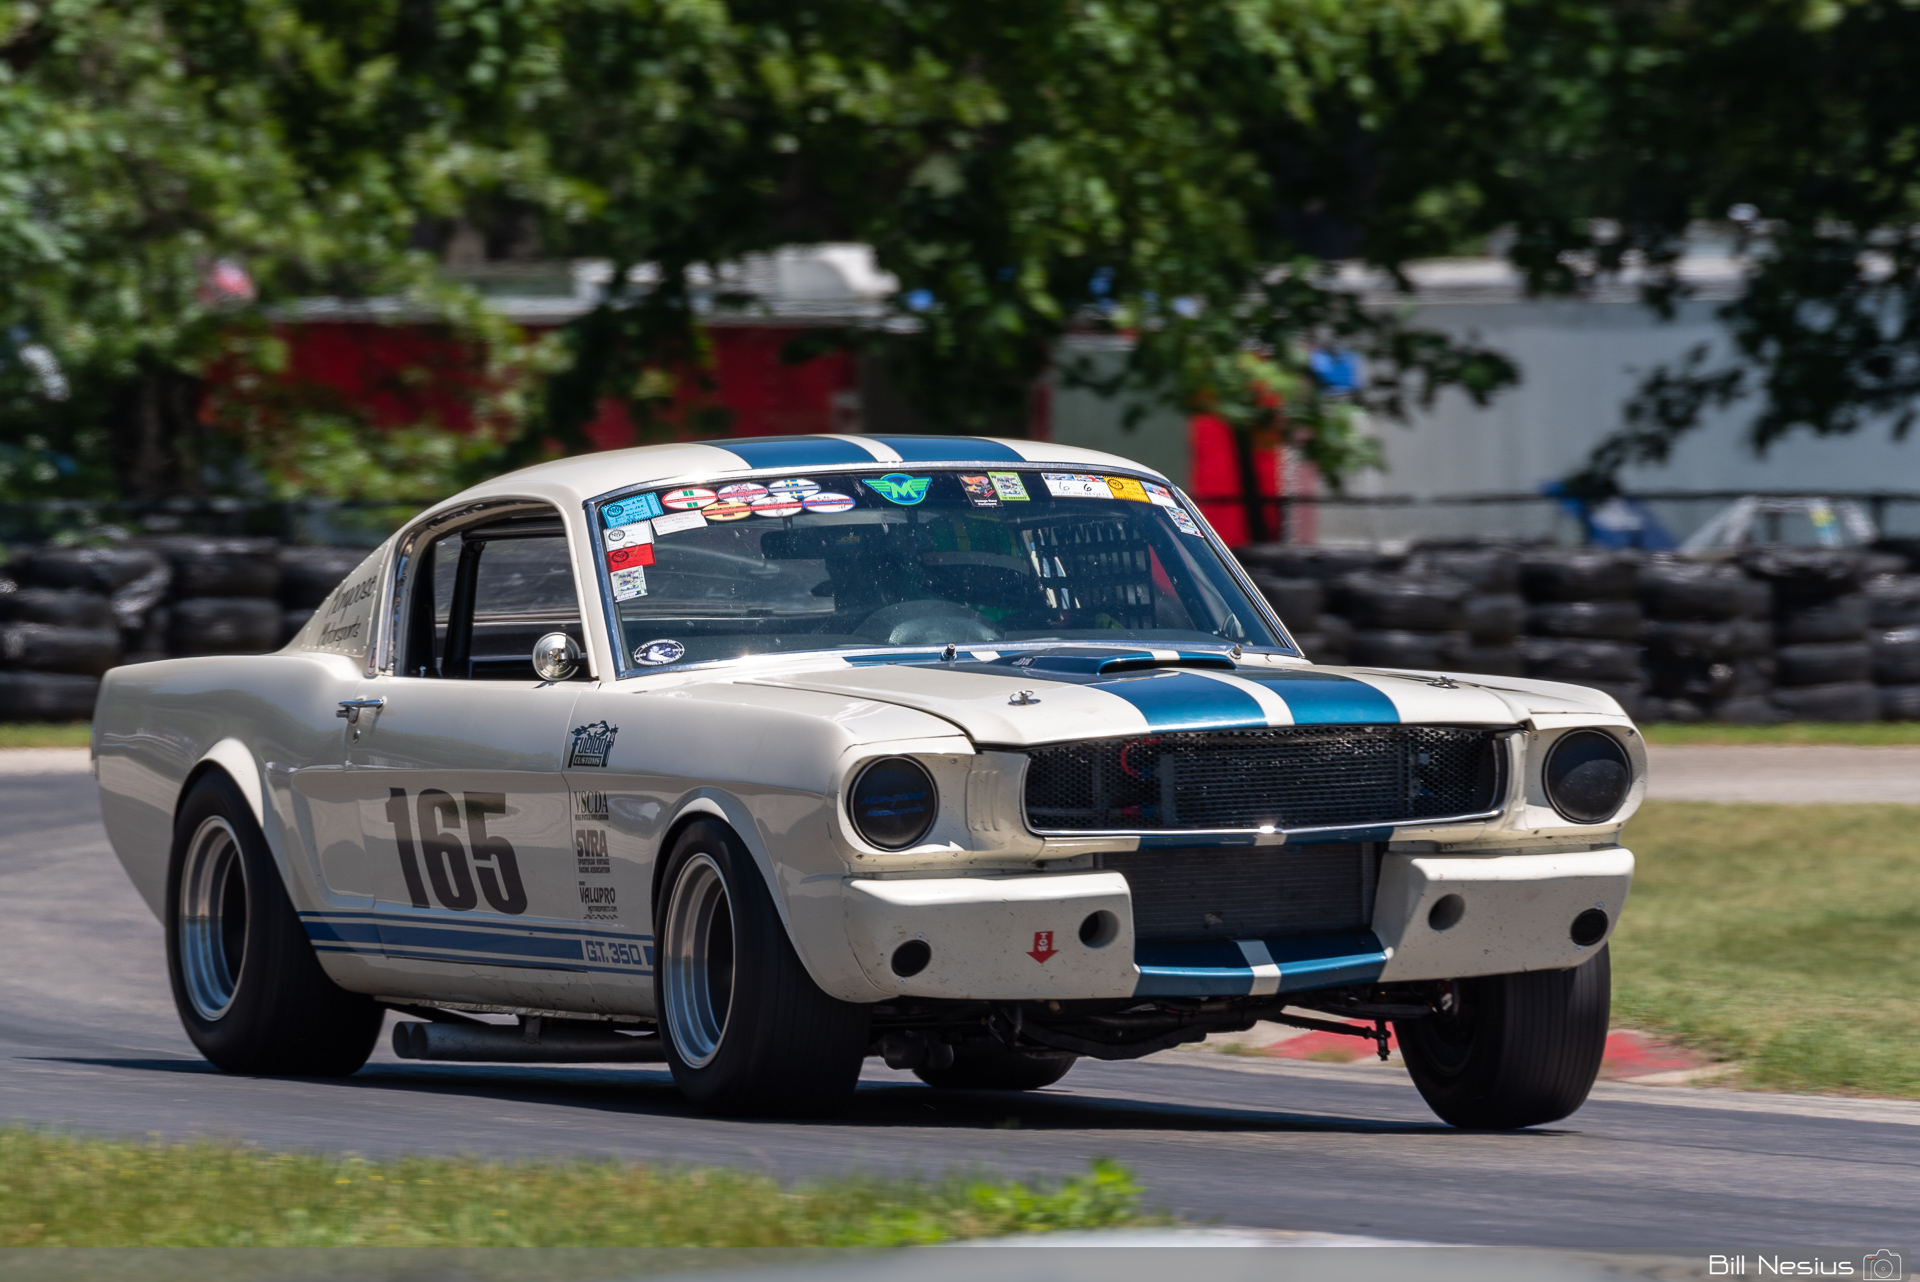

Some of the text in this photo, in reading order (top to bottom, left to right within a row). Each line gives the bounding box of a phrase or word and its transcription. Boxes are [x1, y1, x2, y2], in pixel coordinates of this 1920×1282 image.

[574, 756, 601, 765] CUSTOMS
[574, 791, 609, 813] VSCDA
[385, 787, 528, 915] 165
[576, 830, 608, 857] SVRA
[580, 887, 616, 904] VALUPRO
[1037, 933, 1049, 952] TOW
